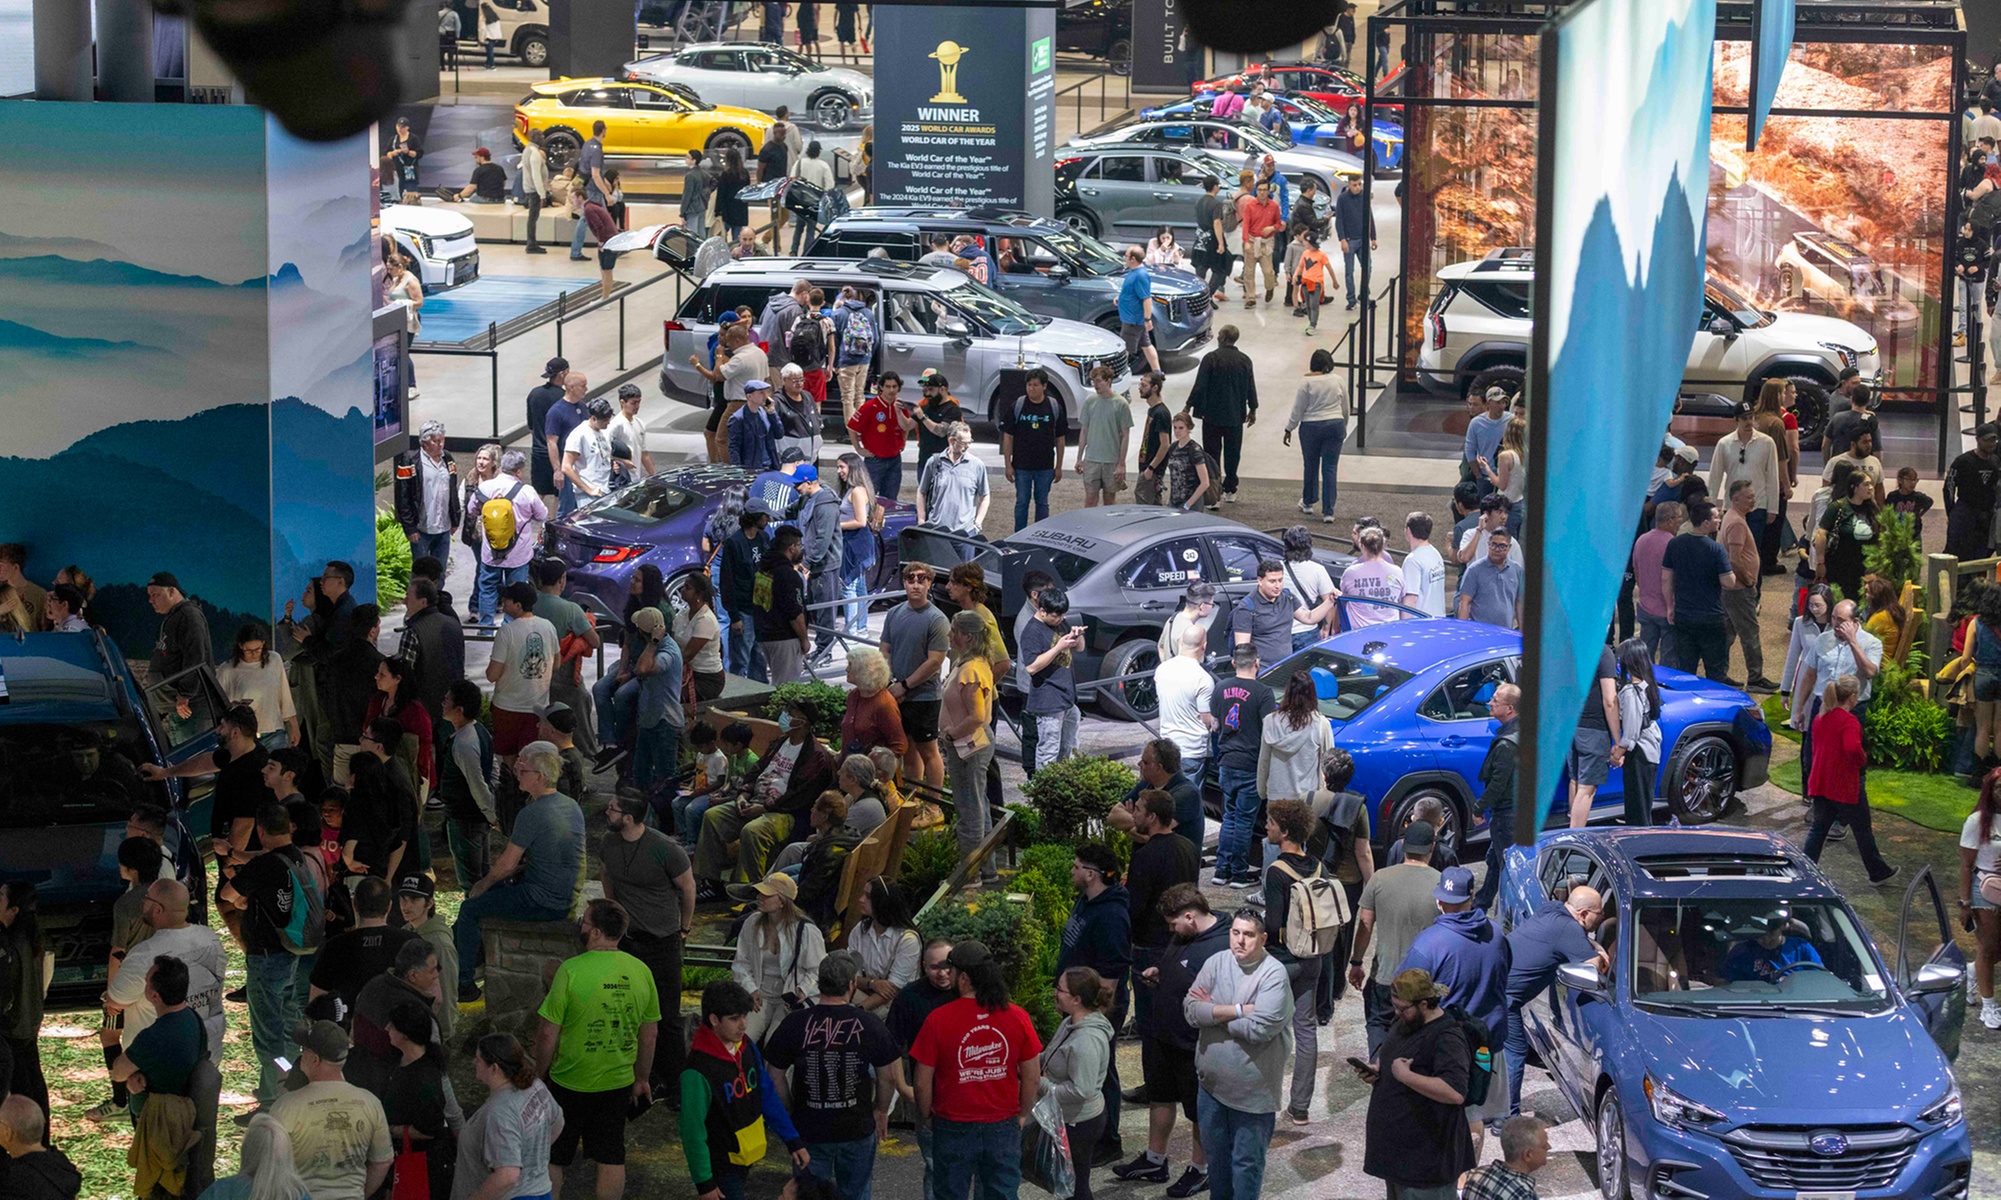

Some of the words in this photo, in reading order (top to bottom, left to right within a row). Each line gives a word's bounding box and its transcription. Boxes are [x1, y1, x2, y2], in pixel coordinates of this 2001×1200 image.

[1164, 0, 1175, 18] TO
[1163, 22, 1175, 64] BUILT
[917, 107, 980, 122] WINNER
[901, 124, 920, 132] 2025
[948, 125, 964, 133] CAR
[964, 126, 996, 134] AWARDS
[901, 136, 930, 144] WORLD
[930, 137, 946, 145] CAR
[947, 137, 959, 145] OF
[958, 137, 975, 146] THE
[975, 138, 996, 146] YEAR
[905, 153, 929, 161] World
[929, 154, 944, 162] Car
[944, 154, 954, 162] of
[954, 154, 968, 163] the
[887, 161, 899, 169] The
[900, 161, 910, 169] Kia
[924, 162, 945, 170] earned
[946, 163, 956, 171] the
[956, 164, 989, 173] prestigious
[990, 164, 1001, 172] title
[931, 171, 944, 179] Car
[944, 171, 952, 179] of
[952, 171, 964, 179] the
[905, 185, 929, 193] World
[929, 186, 944, 194] Car
[944, 185, 954, 194] of
[954, 186, 968, 195] the
[891, 193, 908, 201] 2024
[932, 195, 953, 203] earned
[964, 196, 998, 205] prestigious
[1031, 529, 1097, 550] SUBARU
[1158, 570, 1185, 582] SPEED
[1354, 577, 1381, 588] HAVE
[1358, 588, 1366, 597] A
[1368, 588, 1391, 597] GOOD
[1224, 702, 1241, 731] 4
[362, 935, 383, 948] 2017
[185, 988, 220, 1004] KENNETH
[191, 998, 211, 1010] COLE
[802, 1013, 865, 1050] SLAYER
[984, 1066, 1007, 1075] JUST
